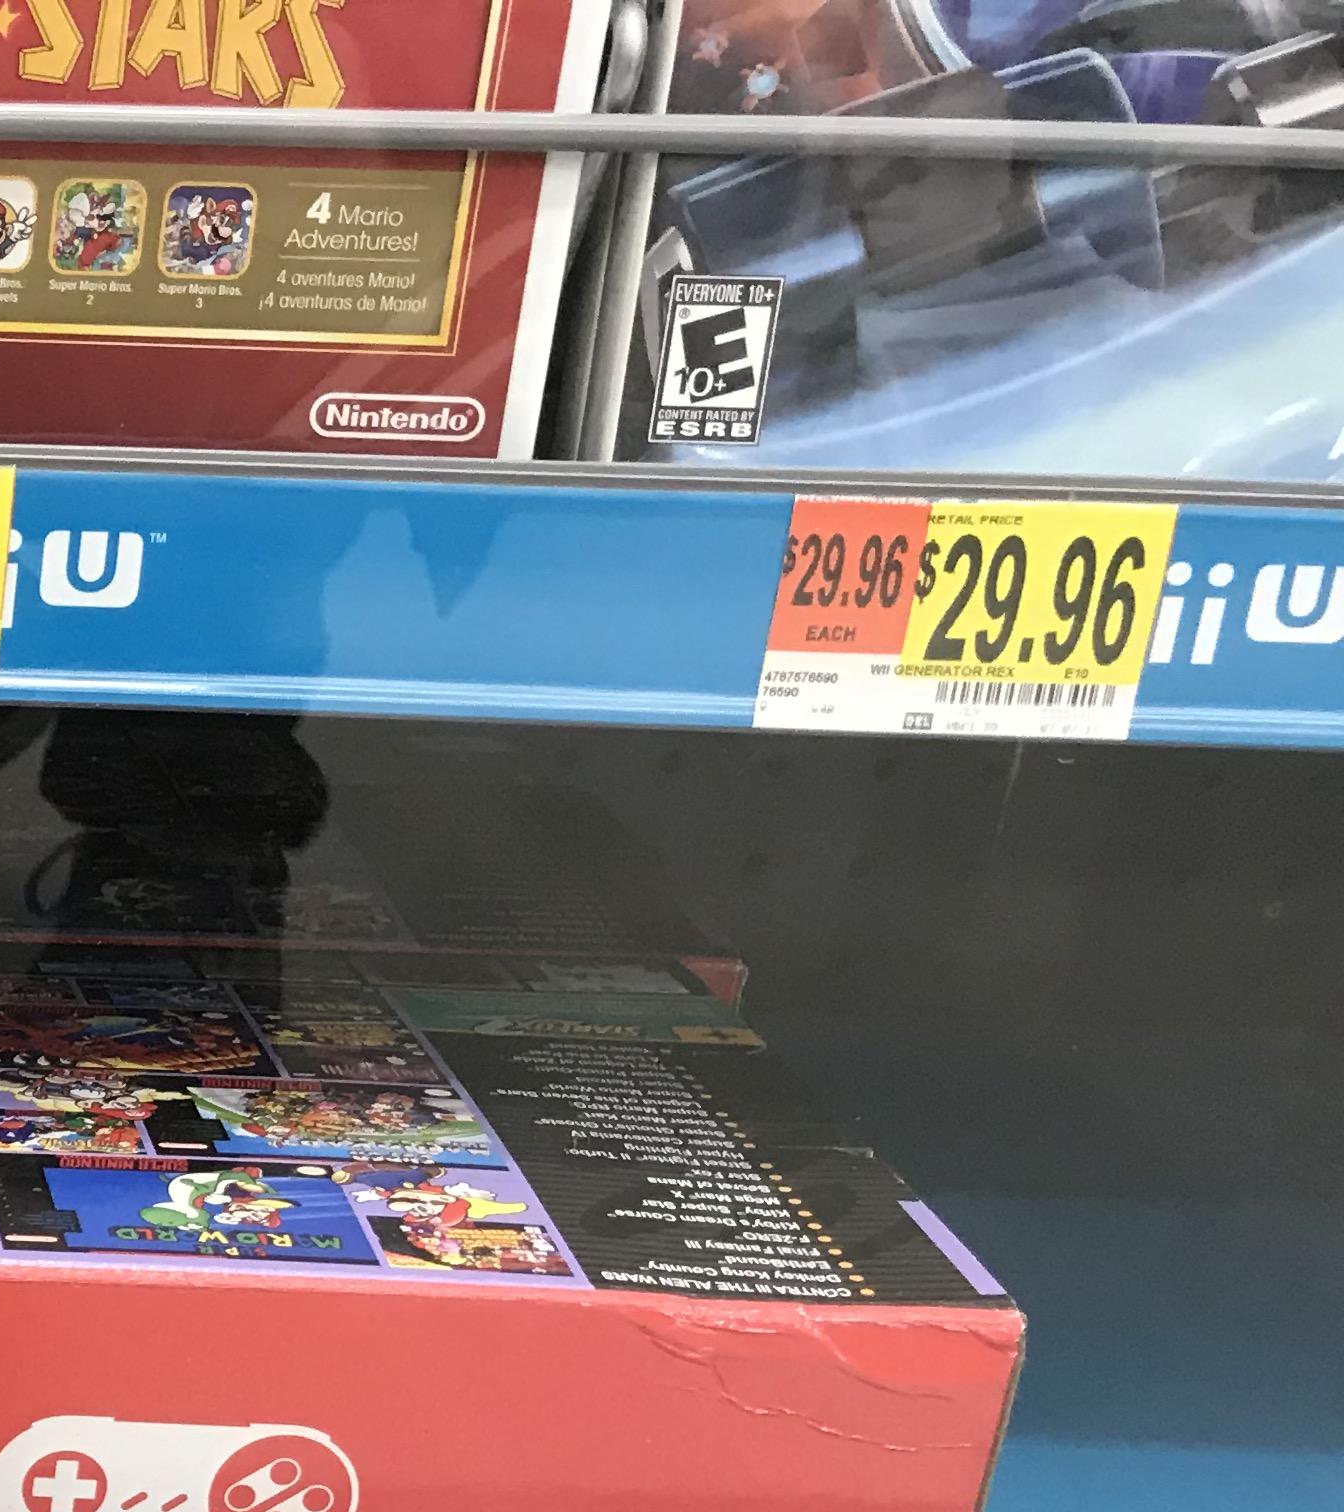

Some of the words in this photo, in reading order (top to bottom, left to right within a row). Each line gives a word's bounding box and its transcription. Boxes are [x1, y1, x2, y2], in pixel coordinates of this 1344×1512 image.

[306, 192, 332, 224] 4
[338, 204, 403, 227] Mario
[284, 228, 418, 251] Adventures!
[49, 279, 77, 293] Super
[79, 280, 107, 292] Mario
[276, 269, 287, 284] 4
[291, 271, 364, 288] aventures
[368, 272, 415, 289] Mario!
[158, 282, 187, 296] Super
[189, 283, 216, 295] Mario
[676, 283, 744, 303] EVERYONE
[749, 285, 775, 303] 10+
[86, 294, 94, 305] 2
[195, 297, 203, 309] 3
[279, 294, 352, 310] aventuras
[357, 294, 375, 311] de
[380, 295, 427, 312] Mario!
[681, 307, 755, 403] E
[325, 404, 469, 432] Nintendo
[658, 409, 703, 420] CONTENT
[705, 410, 738, 421] RATED
[741, 411, 755, 422] BY
[656, 421, 752, 437] ESRB
[928, 514, 975, 525] RETAIL
[980, 515, 1023, 526] PRICE
[782, 533, 908, 608] $29.96
[915, 533, 1145, 666] $29.96
[805, 625, 856, 643] EACH
[871, 664, 889, 676] WII
[893, 665, 983, 678] GENERATOR
[987, 665, 1014, 678] REX
[705, 1240, 774, 1254] Fantasy
[777, 1247, 820, 1257] Final
[601, 1271, 657, 1284] WARS
[720, 1267, 771, 1280] Kong
[774, 1270, 842, 1283] Donkey
[659, 1277, 711, 1290] ALIEN
[715, 1281, 754, 1292] THE
[755, 1284, 772, 1294] III
[772, 1285, 852, 1297] CONTRA
